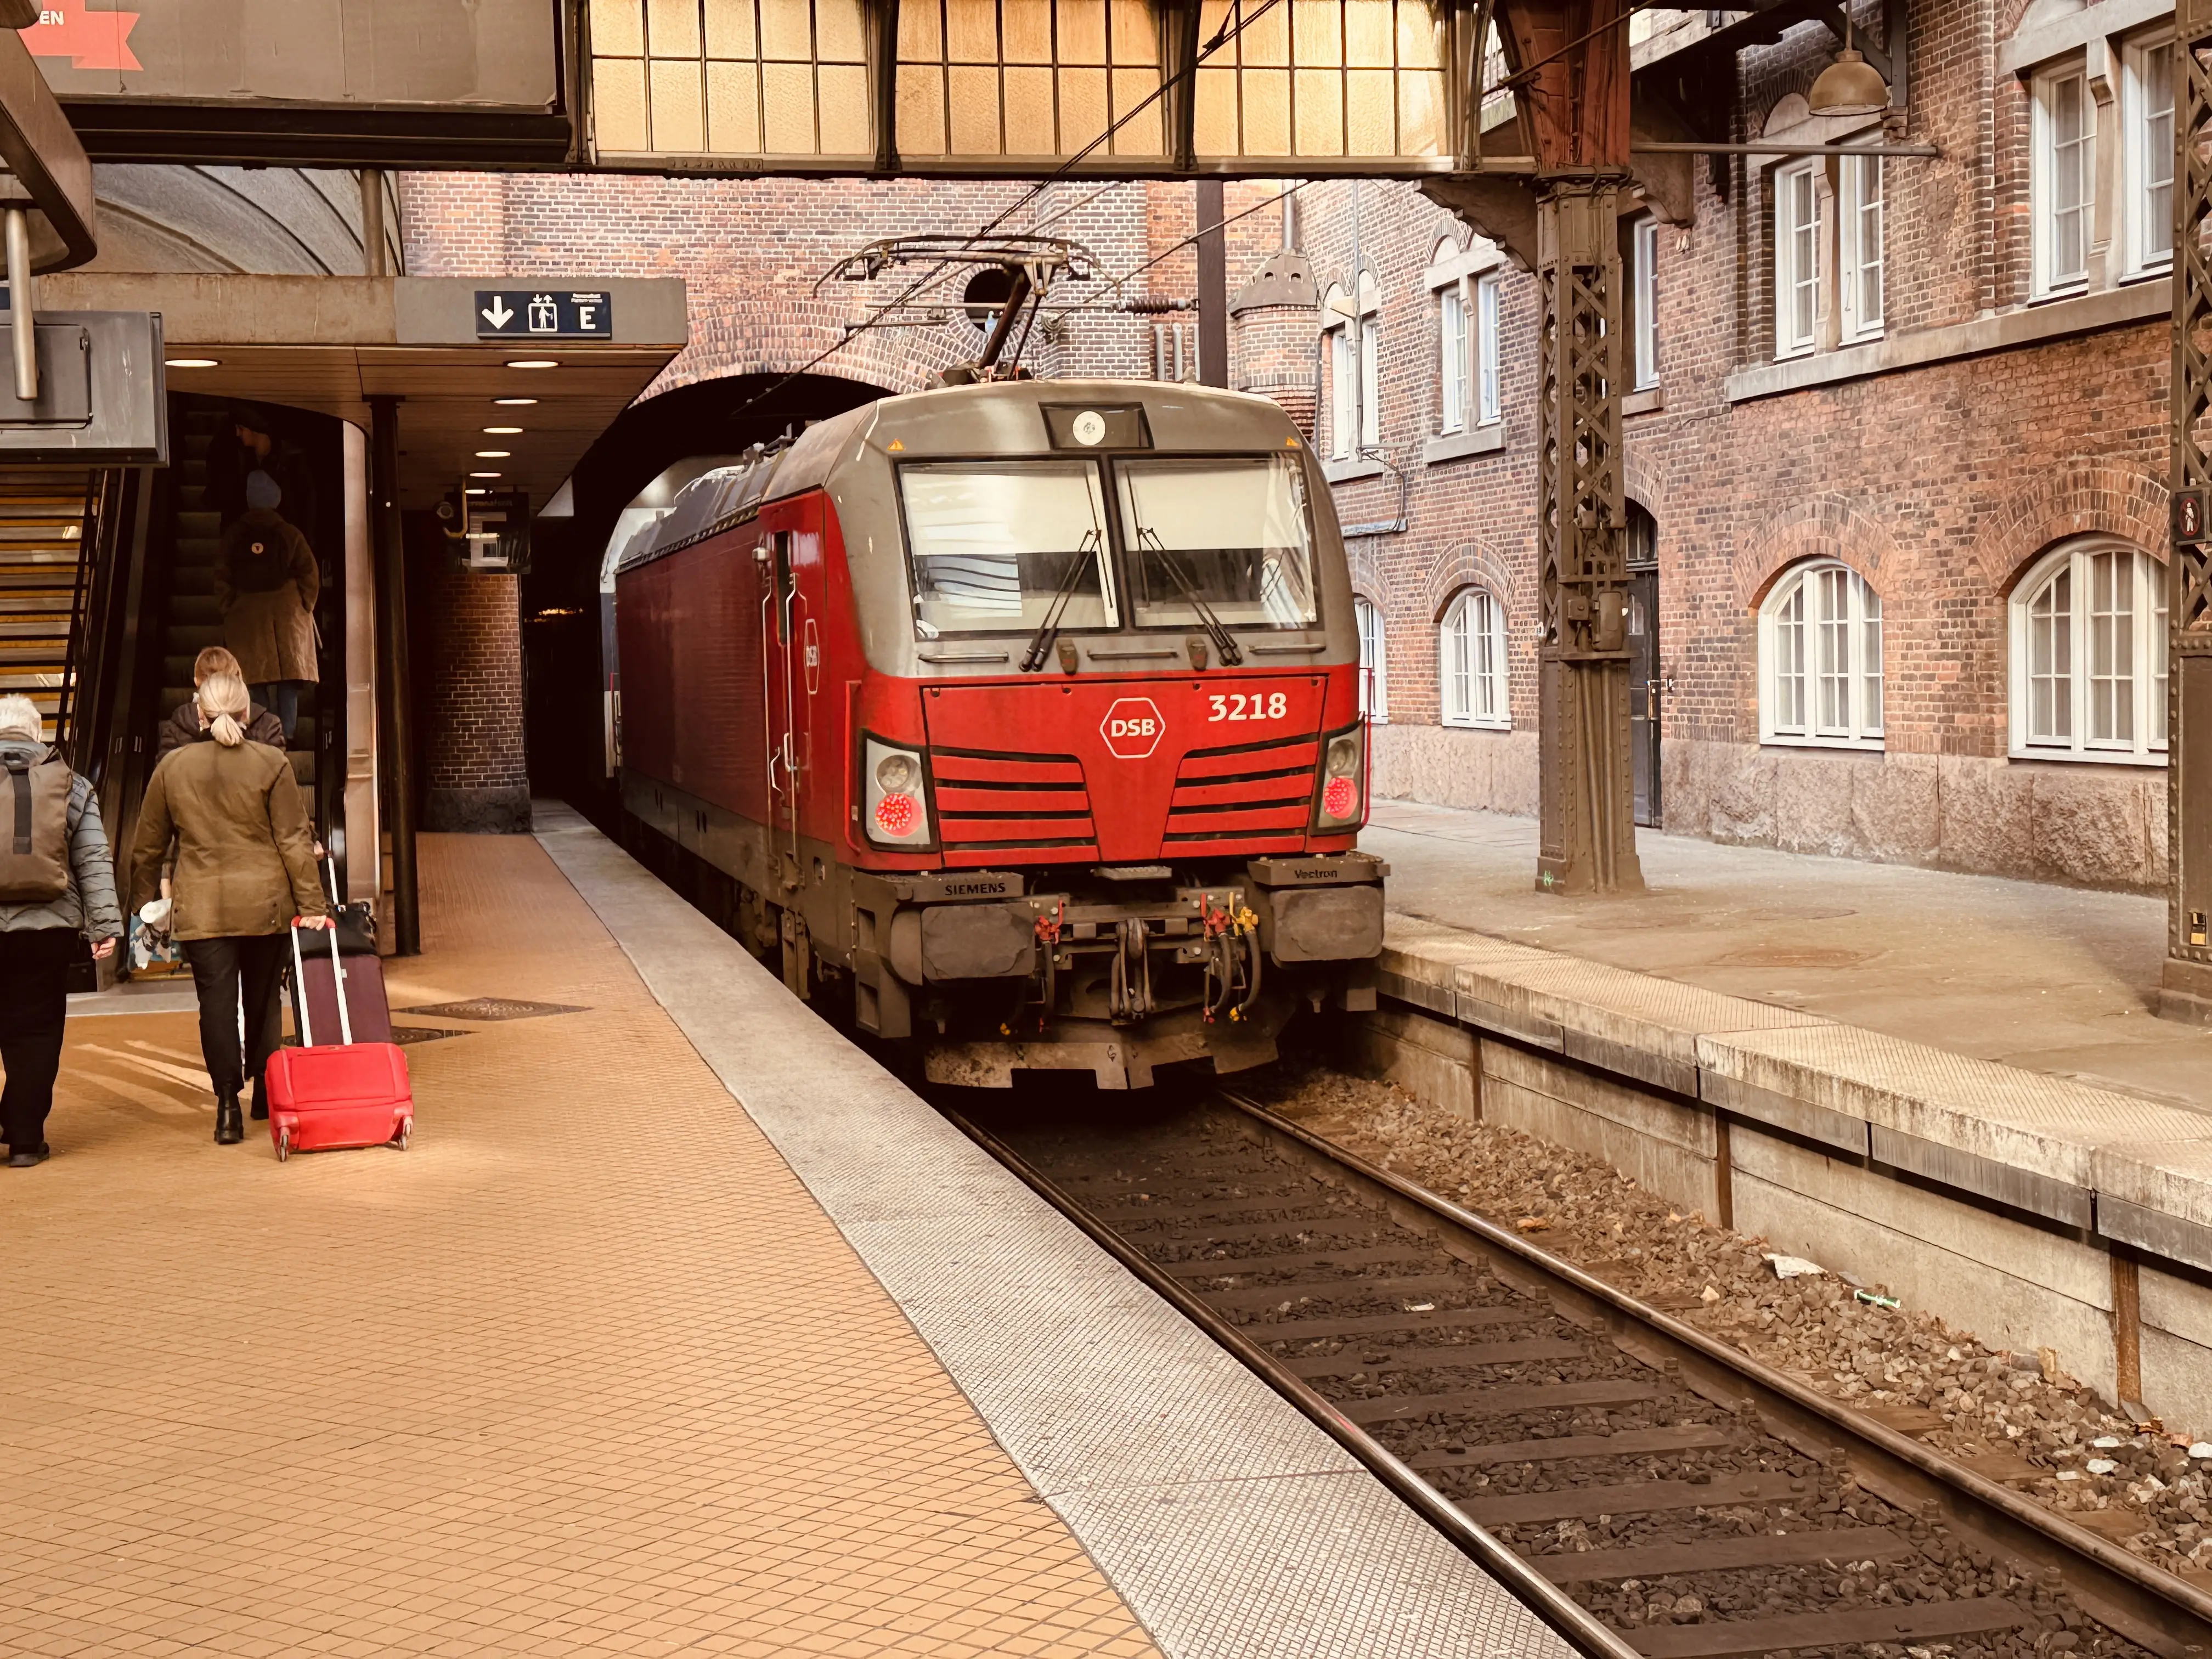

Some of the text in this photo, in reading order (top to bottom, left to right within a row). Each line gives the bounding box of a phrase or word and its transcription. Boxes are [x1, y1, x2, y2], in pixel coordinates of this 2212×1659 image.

[579, 306, 596, 329] E
[469, 511, 509, 567] E
[1207, 692, 1287, 722] 3218
[1110, 718, 1156, 737] DSB
[945, 882, 1006, 895] SIEMENS
